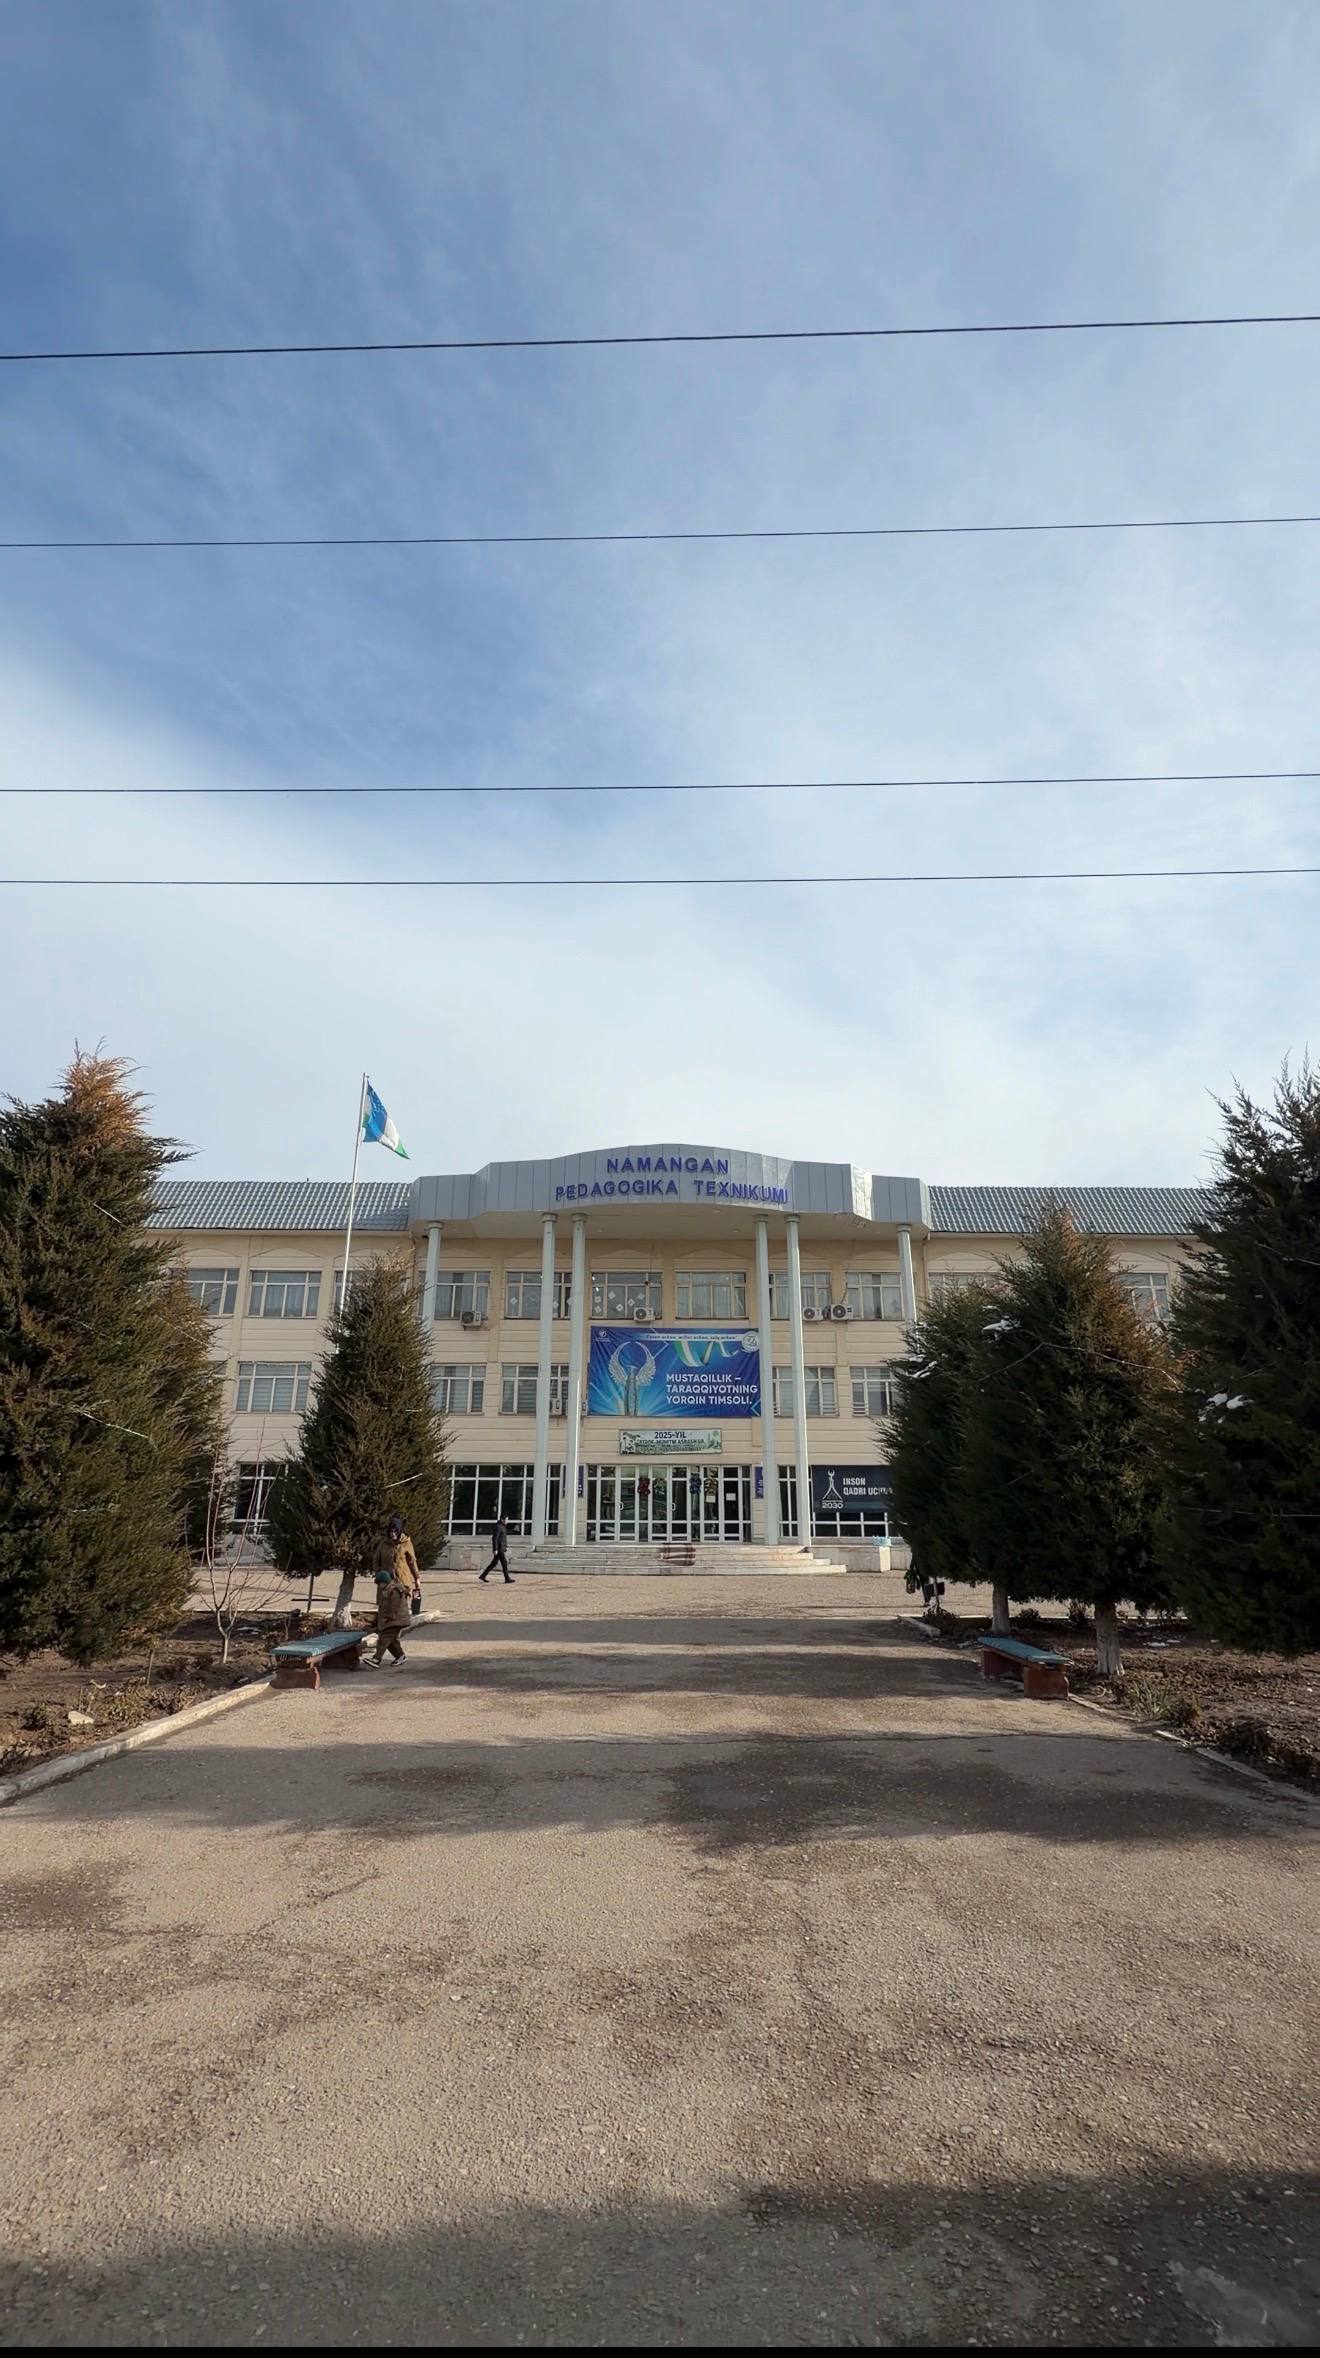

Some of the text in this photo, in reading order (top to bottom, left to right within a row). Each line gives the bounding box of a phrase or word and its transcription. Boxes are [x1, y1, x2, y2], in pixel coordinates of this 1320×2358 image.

[607, 1157, 729, 1174] NAMANGAN
[556, 1180, 788, 1202] PEDAGOGIKA TEXNIKUMI
[666, 1374, 732, 1382] MUSTAQILLIK
[666, 1385, 758, 1393] TARAQQIYOTNING
[666, 1396, 752, 1405] YORQIN TIMSOLI.
[654, 1431, 687, 1439] 2025-YIL
[843, 1478, 866, 1486] INSON
[843, 1487, 866, 1496] QADRI
